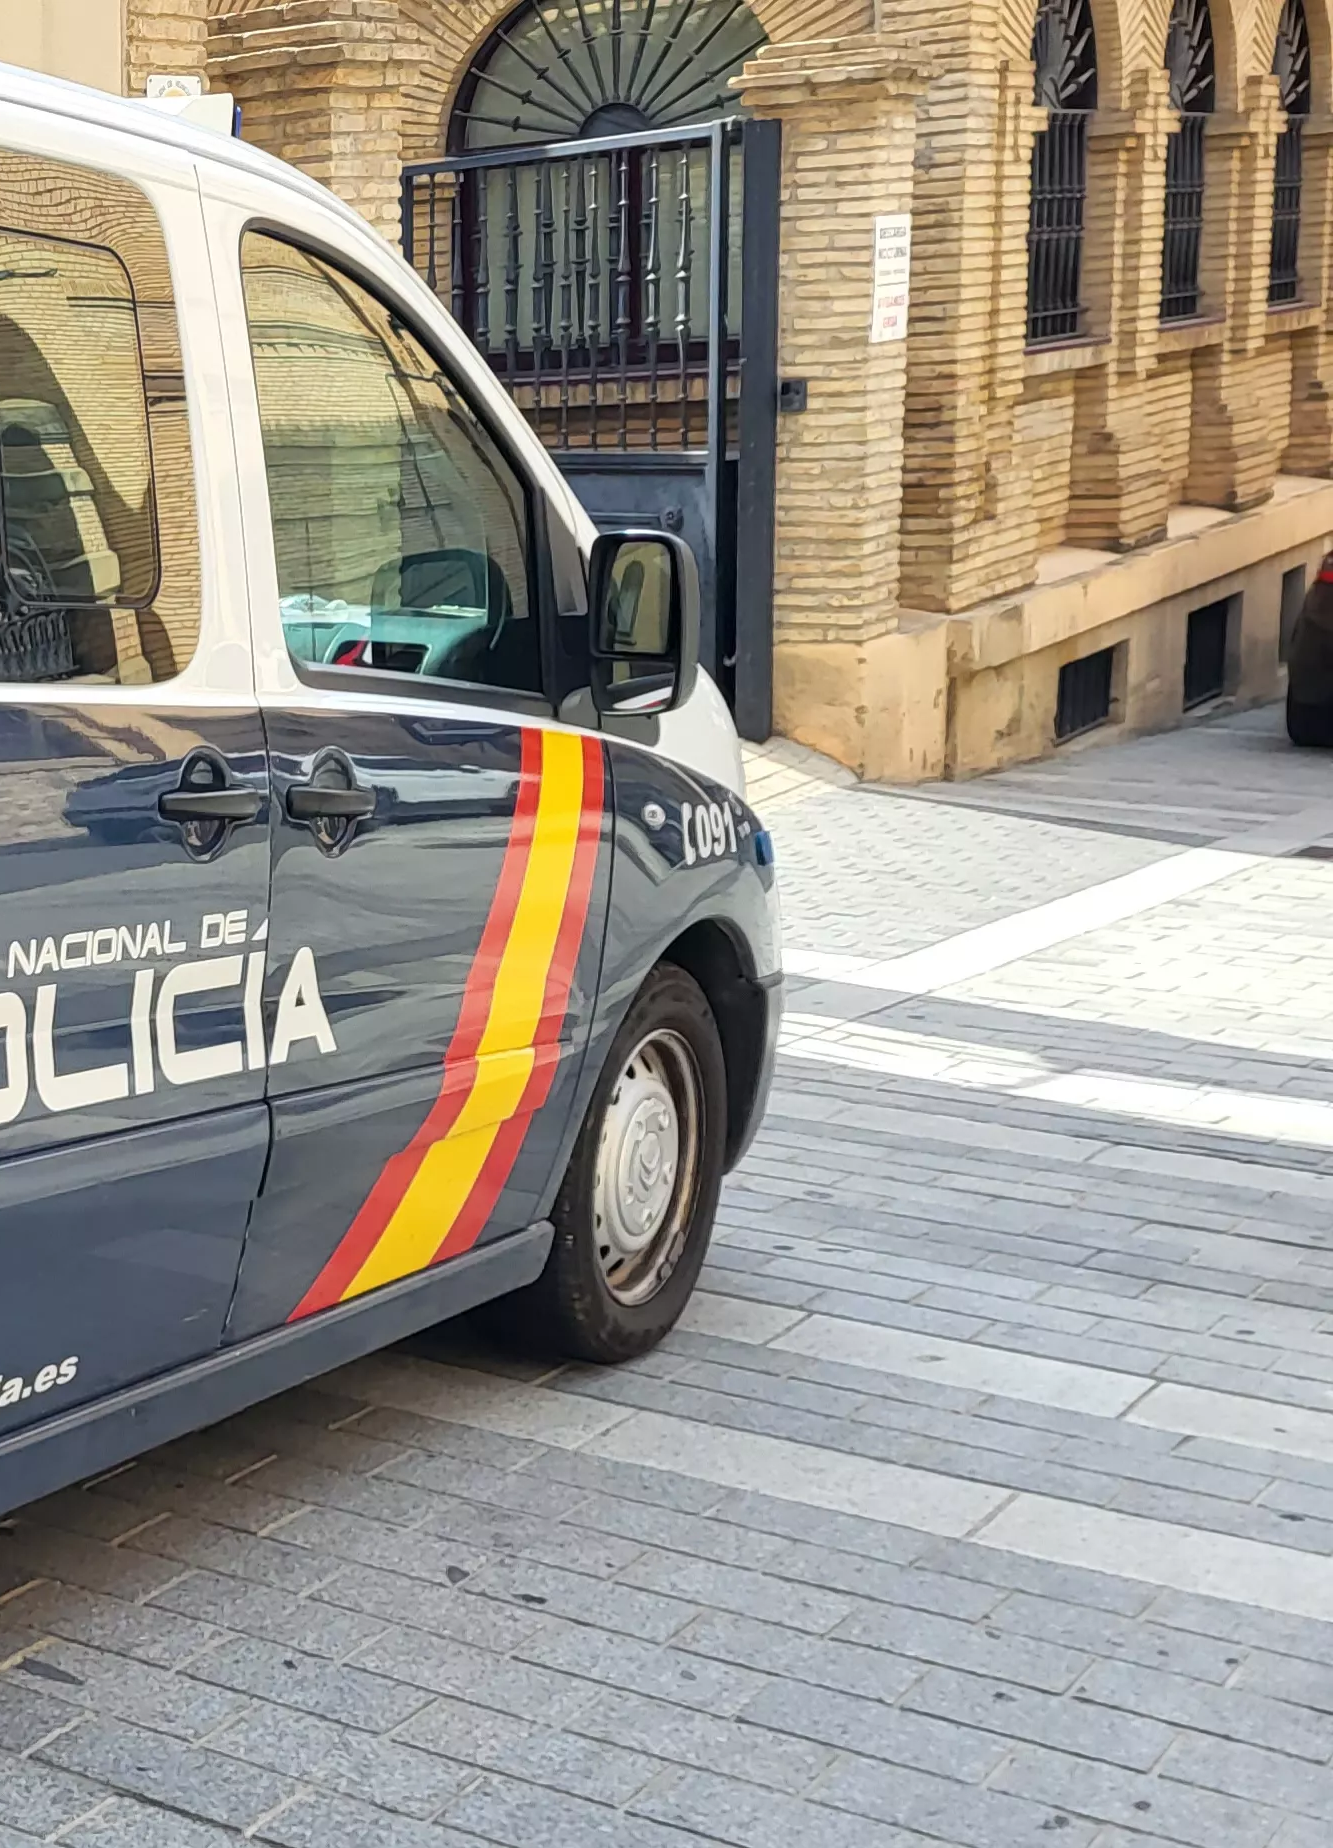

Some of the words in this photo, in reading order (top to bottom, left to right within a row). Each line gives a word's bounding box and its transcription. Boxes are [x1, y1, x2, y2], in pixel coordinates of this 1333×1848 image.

[694, 801, 738, 859] 091
[6, 919, 188, 979] NACIONAL
[200, 909, 249, 950] DE
